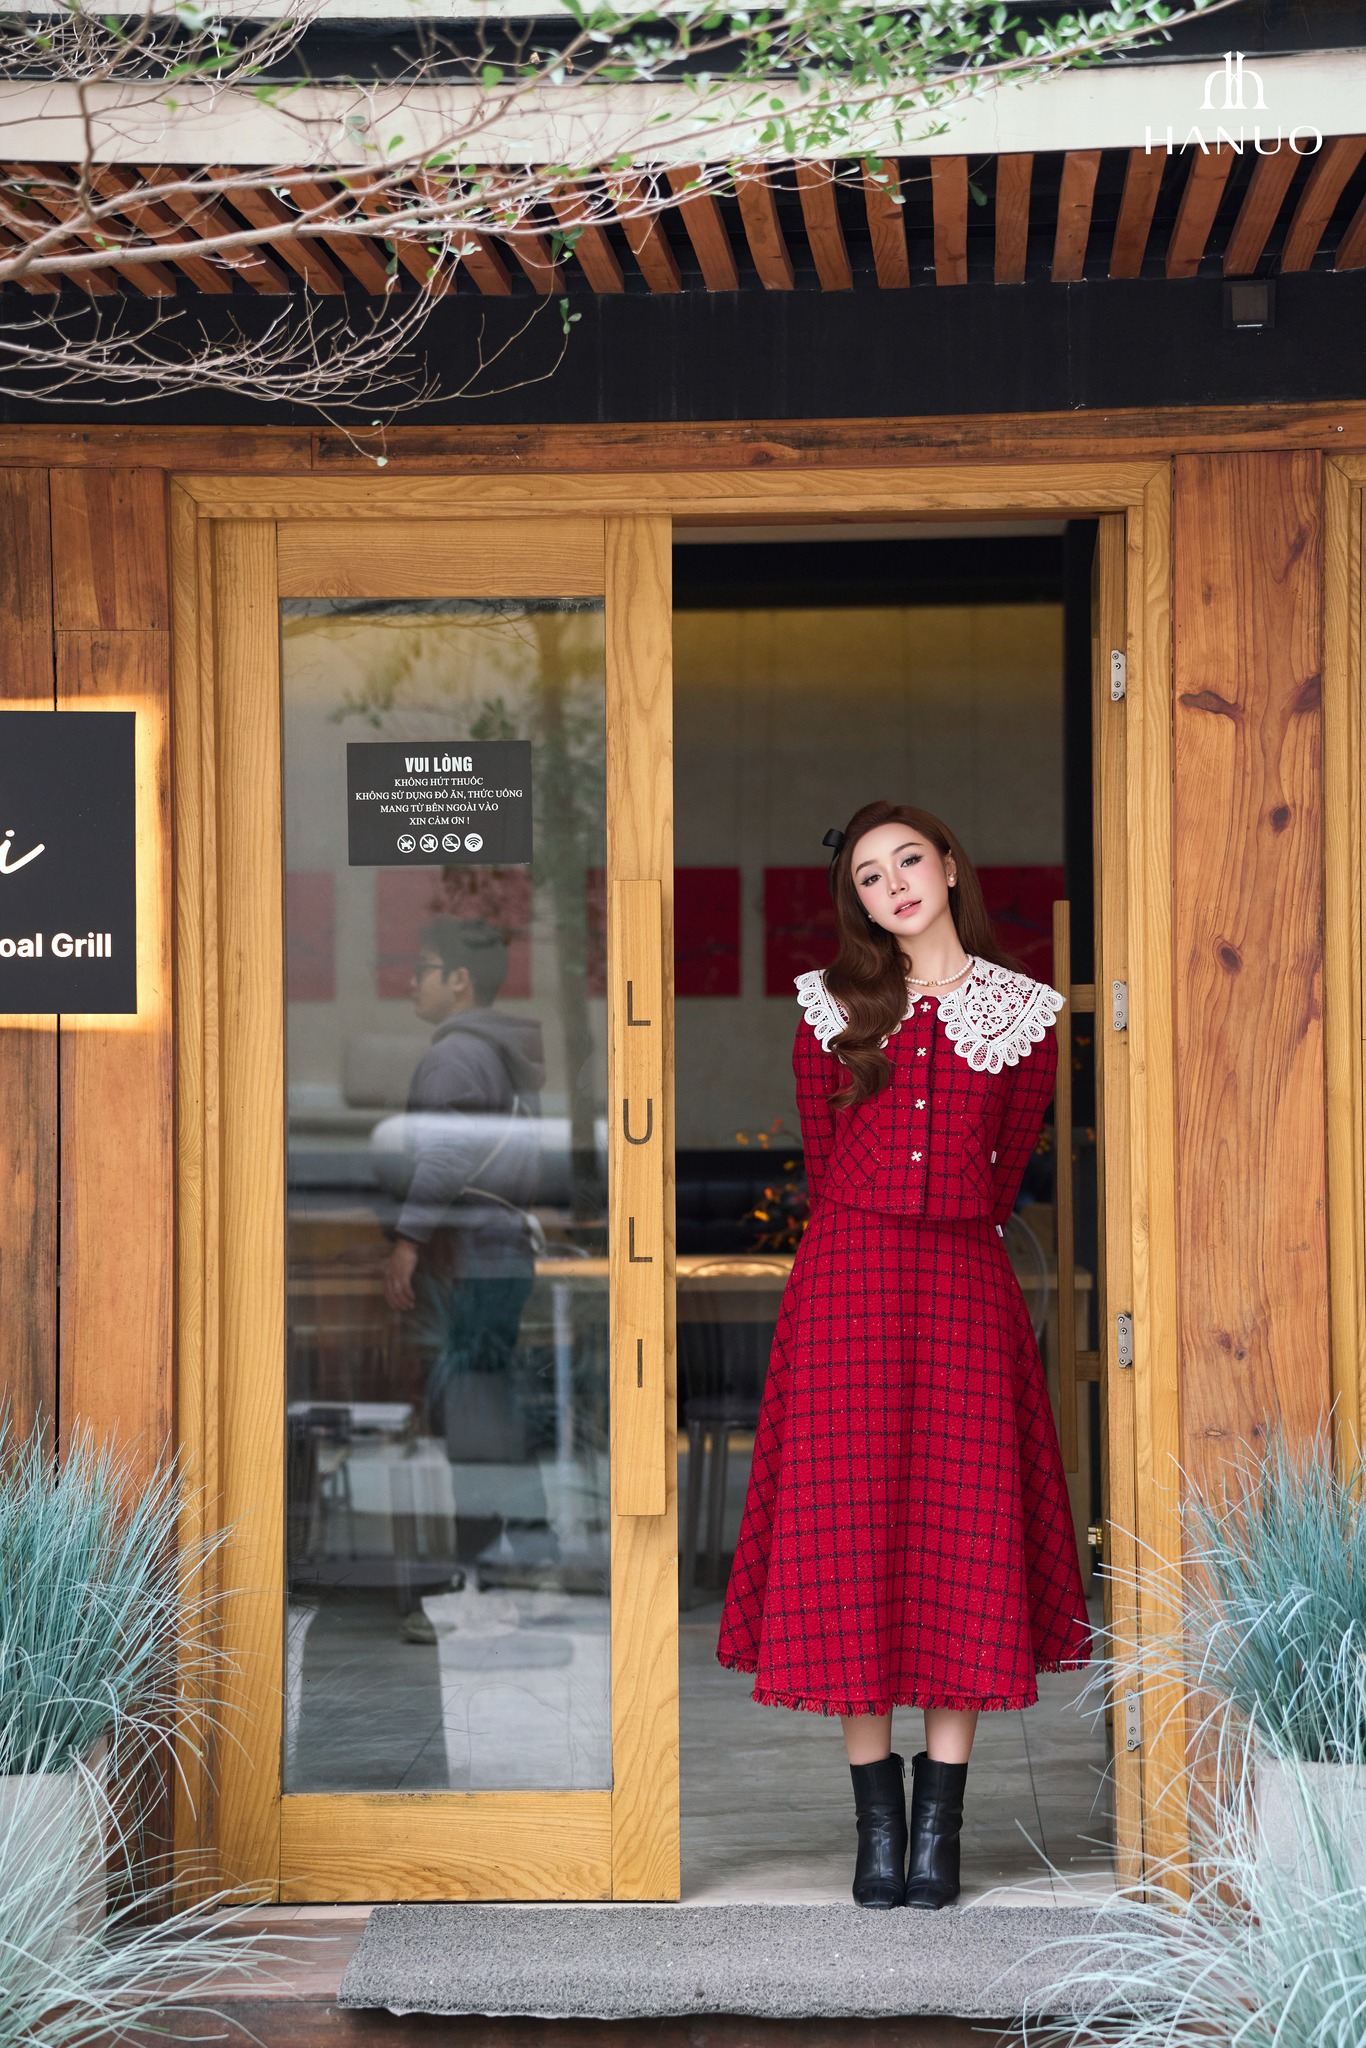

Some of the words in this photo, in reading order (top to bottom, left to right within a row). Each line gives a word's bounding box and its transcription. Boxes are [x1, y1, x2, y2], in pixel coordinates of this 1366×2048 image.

[405, 757, 429, 773] VUI
[434, 753, 473, 772] LÒNG
[394, 776, 429, 787] KHÔNG
[430, 776, 450, 786] HÚT
[355, 790, 390, 801] KHÔNG
[406, 791, 433, 801] DỤNG
[450, 789, 467, 800] ĂN,
[468, 788, 494, 799] THỨC
[380, 804, 410, 813] MANG
[410, 802, 425, 812] TỪ
[425, 802, 445, 812] BÊN
[446, 801, 477, 812] NGOÀI
[478, 800, 499, 811] VÀO
[409, 817, 427, 826] XIN
[427, 815, 450, 825] CẢM
[451, 815, 465, 825] ƠN
[0, 932, 43, 958] oal
[51, 932, 112, 958] Grill
[622, 980, 654, 1389] LULI
